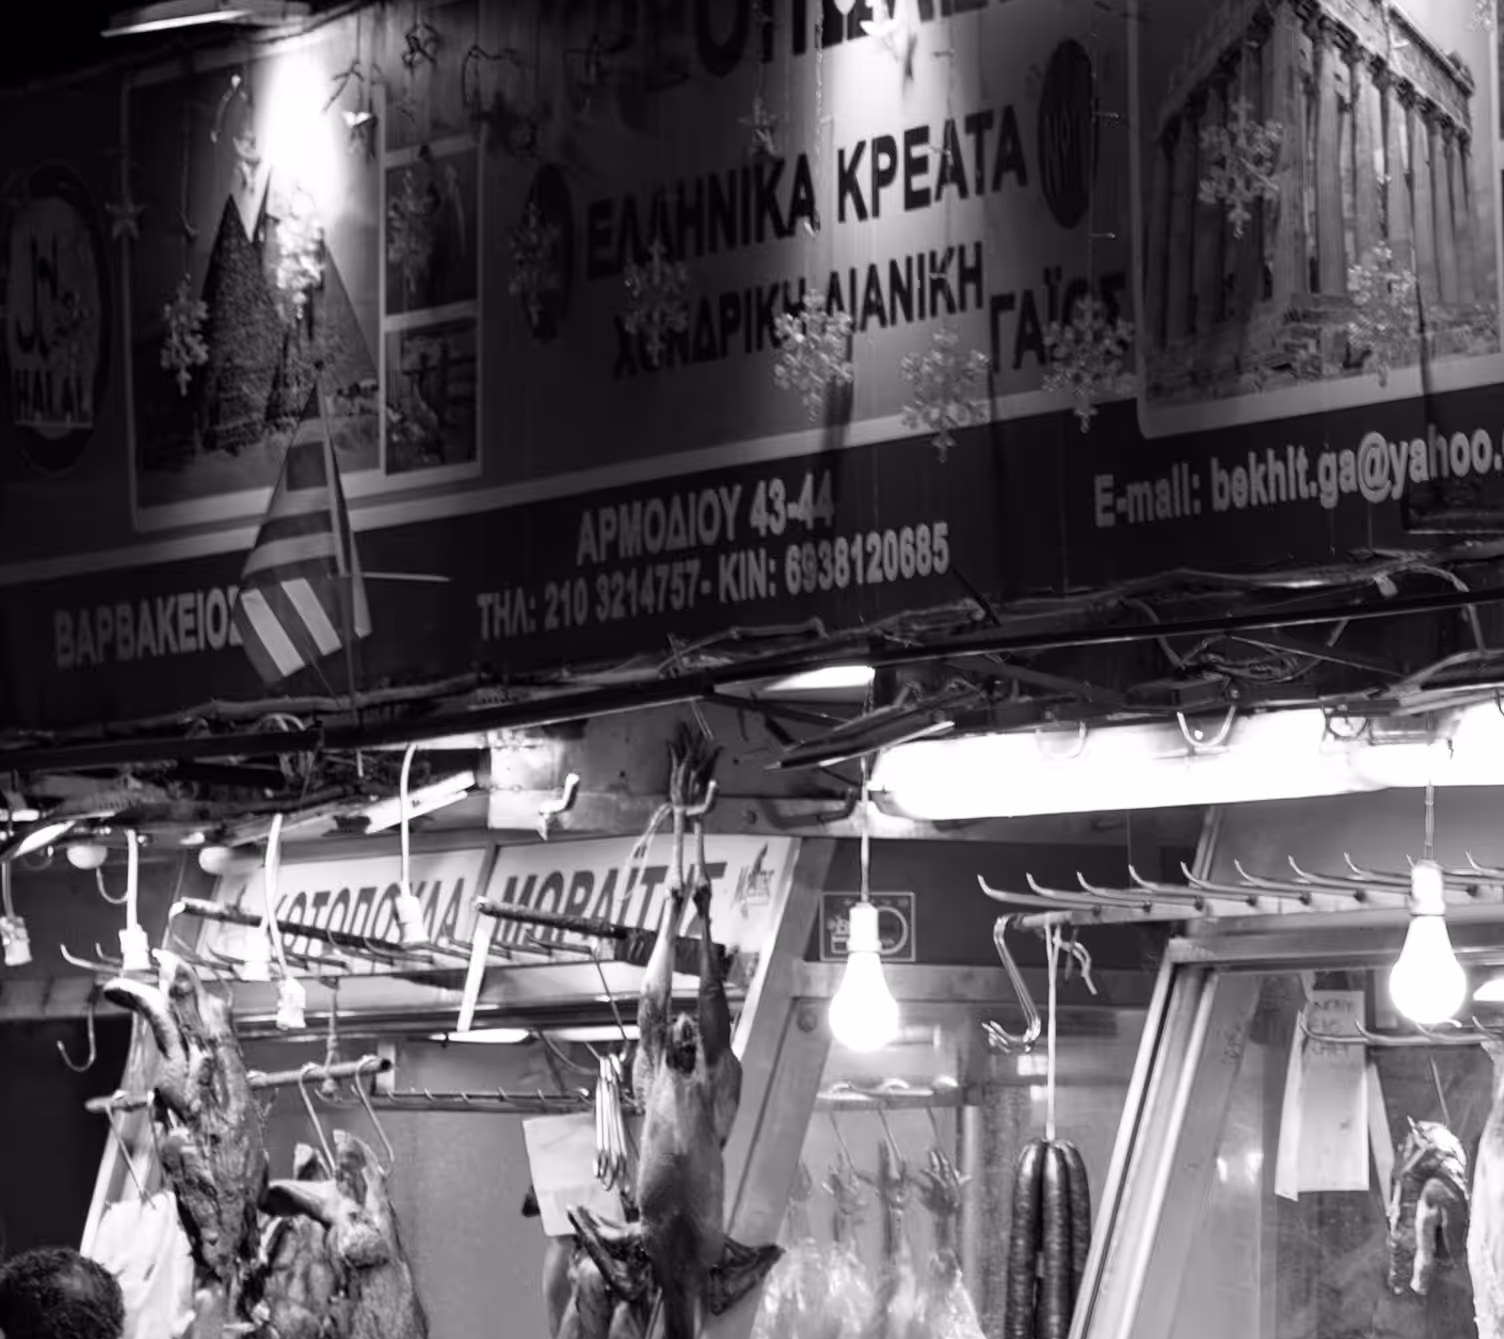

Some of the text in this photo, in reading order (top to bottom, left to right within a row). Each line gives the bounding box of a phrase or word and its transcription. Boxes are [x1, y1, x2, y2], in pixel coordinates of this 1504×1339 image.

[587, 153, 820, 281] ΕΛΛΗΝΙΚΑ
[837, 106, 1028, 223] ΚΡΕΑΤΑ
[575, 469, 835, 566] ΑΡΜΟΔΙΟΥ 43-44
[476, 587, 538, 641] ΤΗΛ:
[543, 580, 589, 630] 210
[717, 546, 777, 604] ΚΙΝ:
[784, 521, 950, 595] 6938120685
